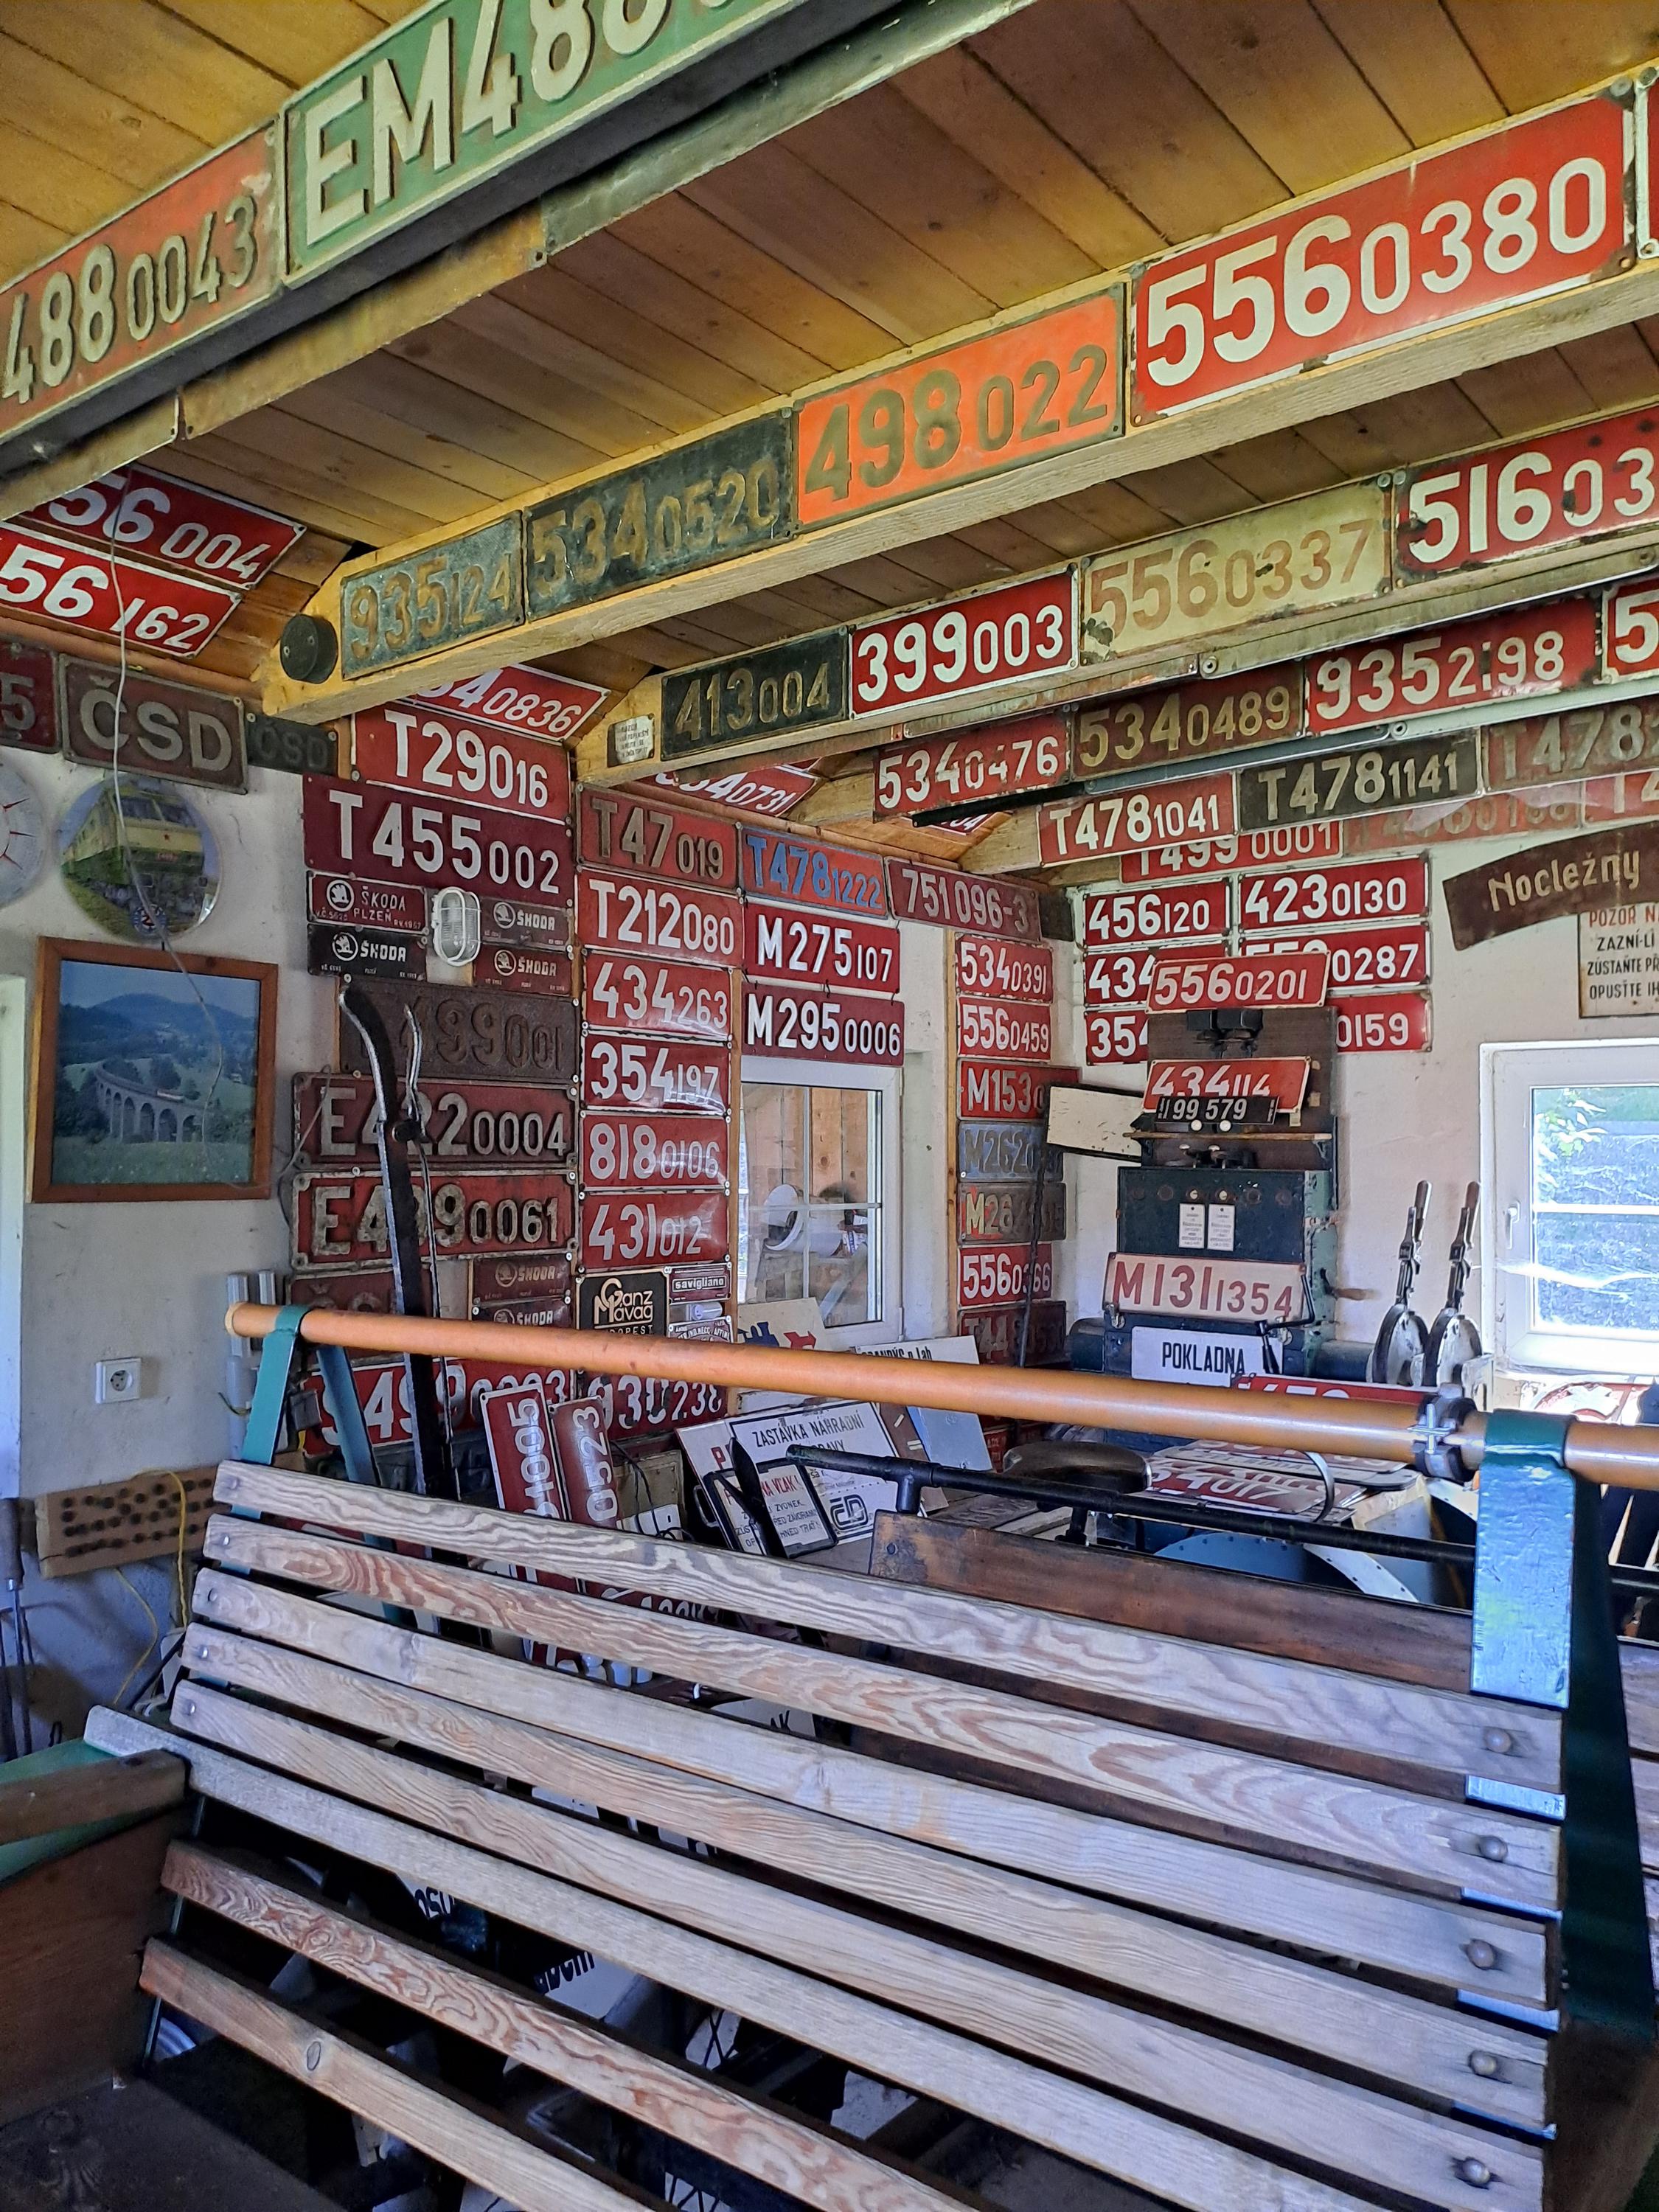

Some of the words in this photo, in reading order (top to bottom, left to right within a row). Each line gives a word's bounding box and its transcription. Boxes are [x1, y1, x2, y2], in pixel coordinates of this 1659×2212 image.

[80, 675, 232, 771] ČSD
[361, 886, 406, 911] ŠKODA
[517, 909, 555, 931] ŠKODA
[1645, 905, 1659, 922] N
[360, 940, 406, 962] ŠKODA
[1162, 1342, 1245, 1374] POKLADNA
